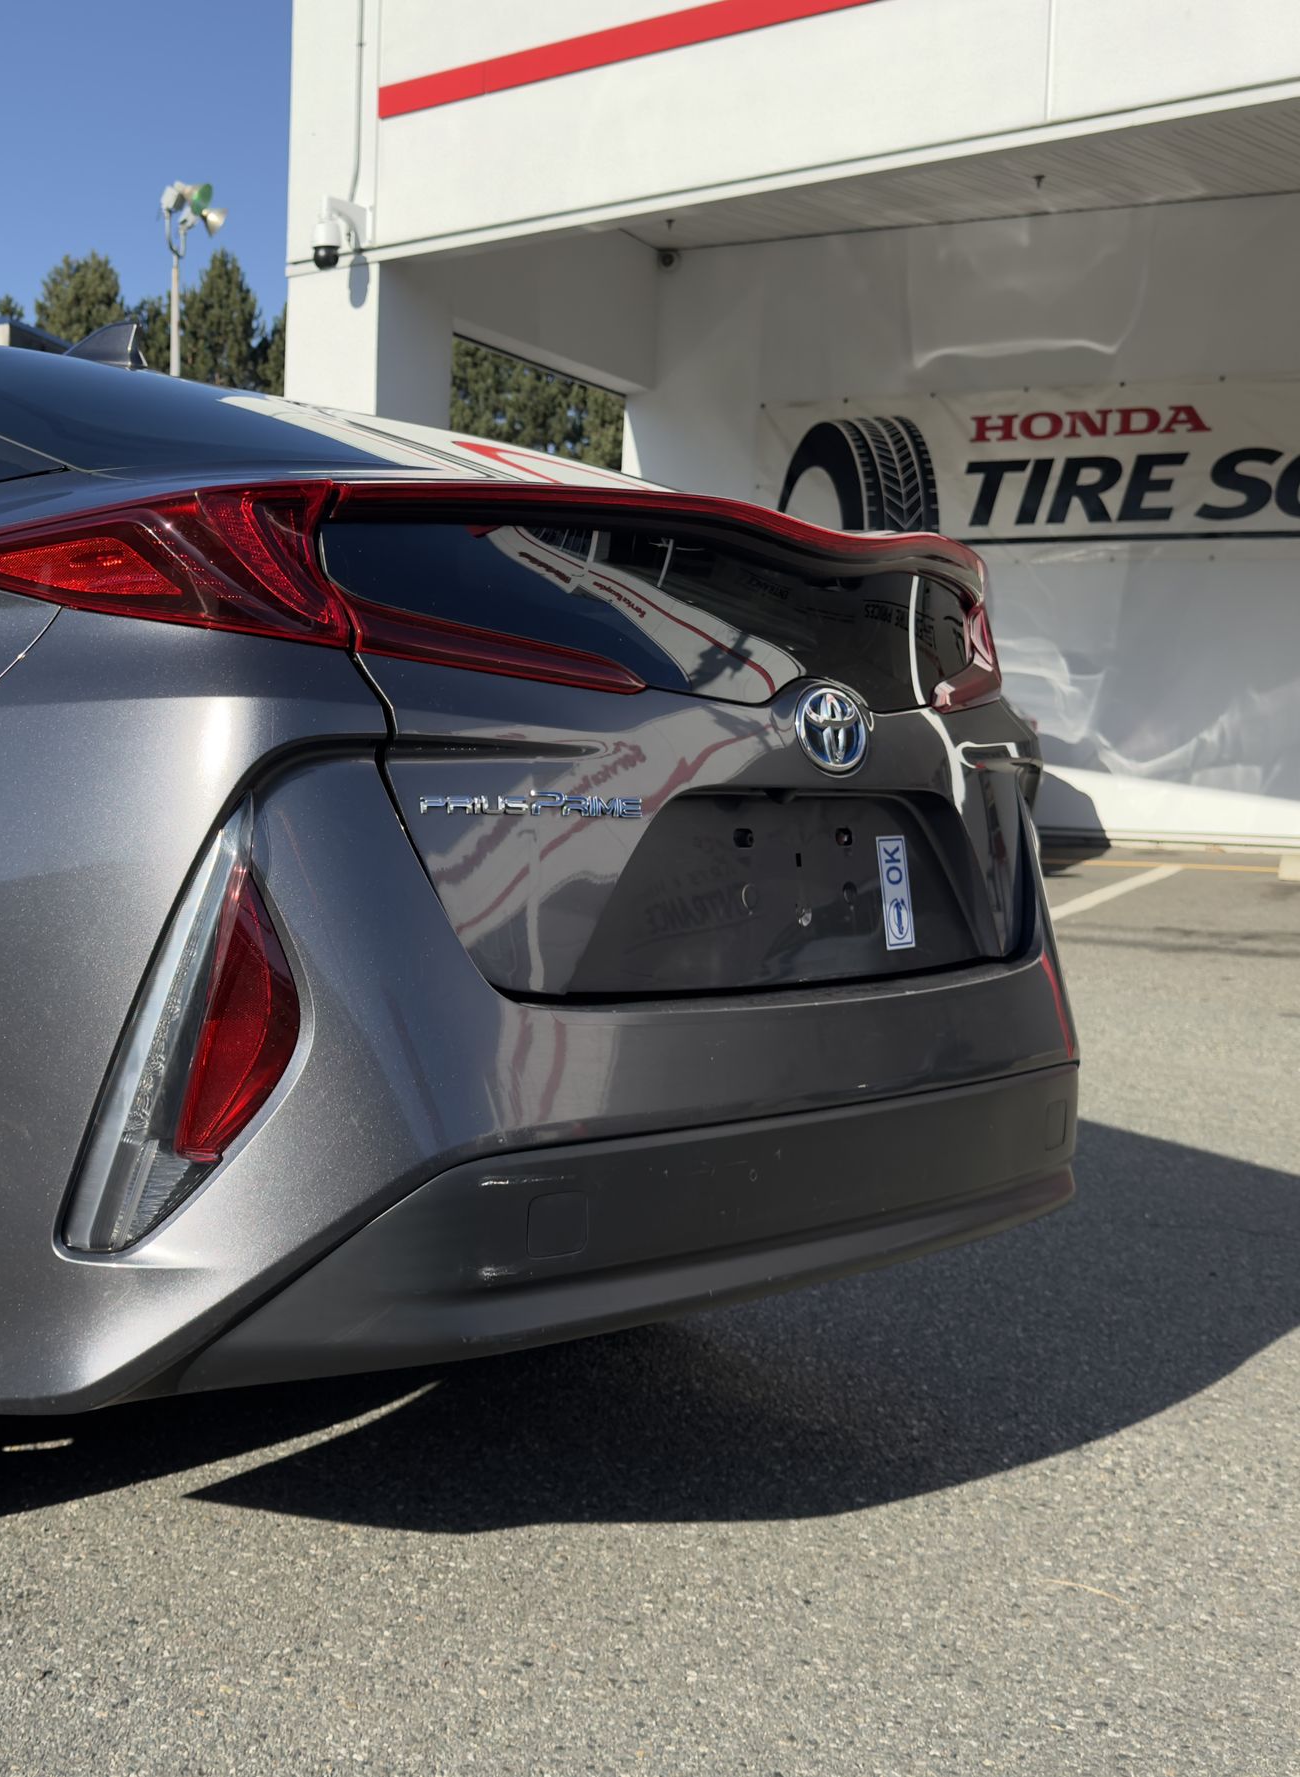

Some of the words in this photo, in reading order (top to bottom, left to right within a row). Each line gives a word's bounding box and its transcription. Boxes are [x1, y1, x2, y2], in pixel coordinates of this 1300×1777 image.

[969, 405, 1212, 443] HONDA
[965, 452, 1190, 526] TIRE
[420, 795, 528, 815] PRIUS
[530, 789, 643, 818] PRIME
[883, 846, 902, 885] OK
